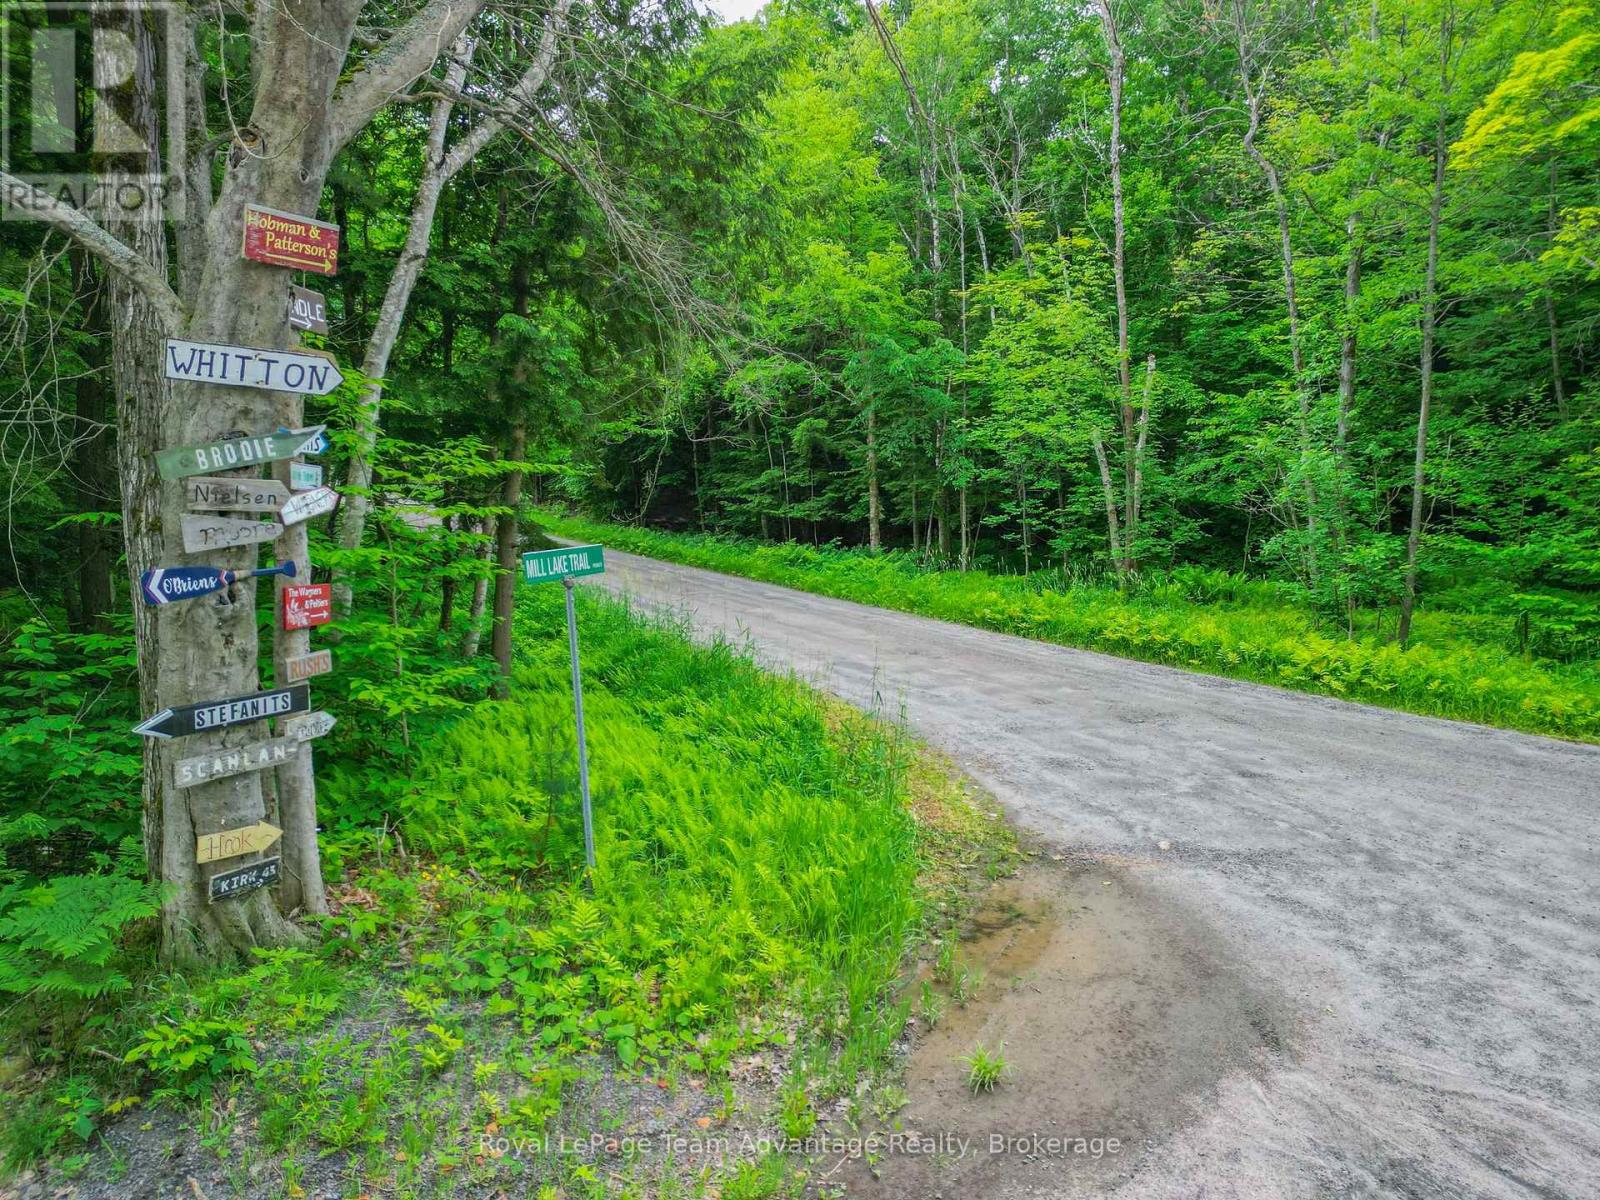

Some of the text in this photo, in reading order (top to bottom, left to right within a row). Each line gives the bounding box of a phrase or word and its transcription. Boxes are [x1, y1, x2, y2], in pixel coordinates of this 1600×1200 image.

[265, 231, 338, 260] Patterson's
[309, 225, 322, 240] &
[291, 299, 325, 323] NDLE
[168, 346, 330, 391] WHITTON
[195, 437, 277, 470] BRODIE
[194, 484, 277, 505] Nielsen
[526, 551, 591, 579] MILL LAKE TRAIL
[163, 576, 218, 594] O'Briens
[196, 694, 290, 728] STEFANITS
[207, 831, 253, 859] Hook
[220, 870, 258, 893] KIRK
